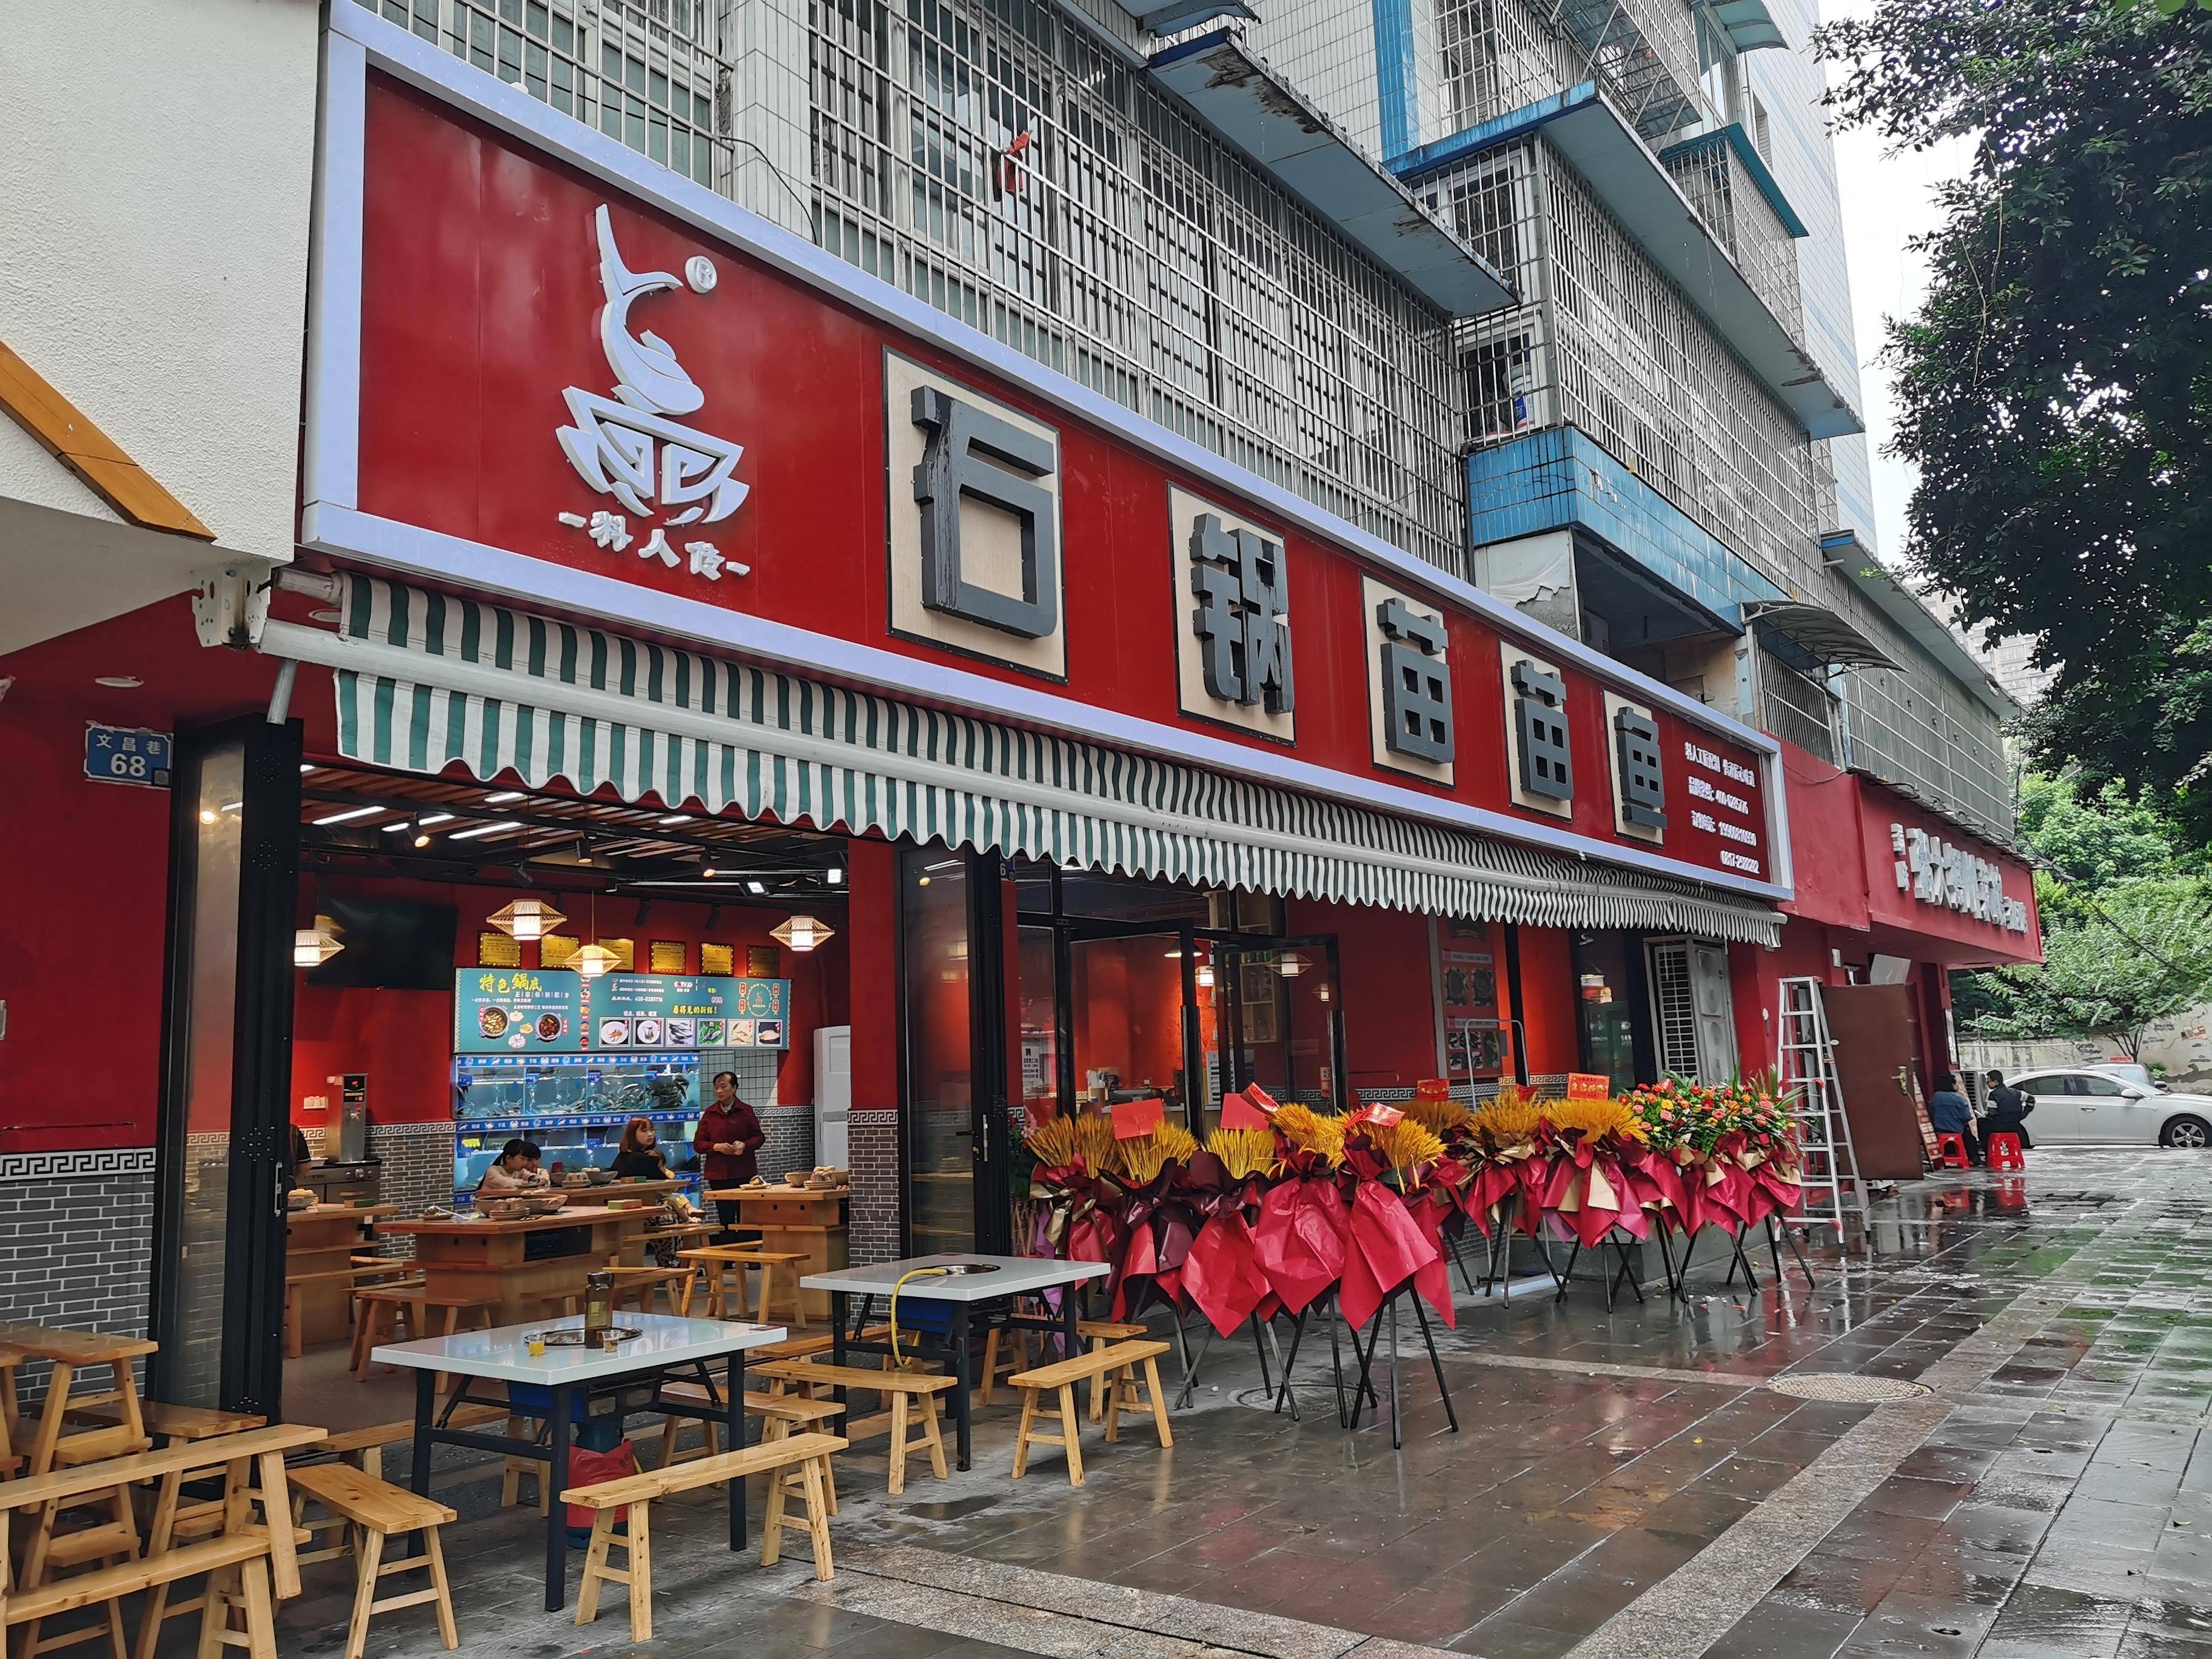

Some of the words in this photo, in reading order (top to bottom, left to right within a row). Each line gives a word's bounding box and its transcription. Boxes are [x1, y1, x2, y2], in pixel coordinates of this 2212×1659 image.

[96, 734, 161, 754] 文昌巷
[110, 753, 146, 777] 68
